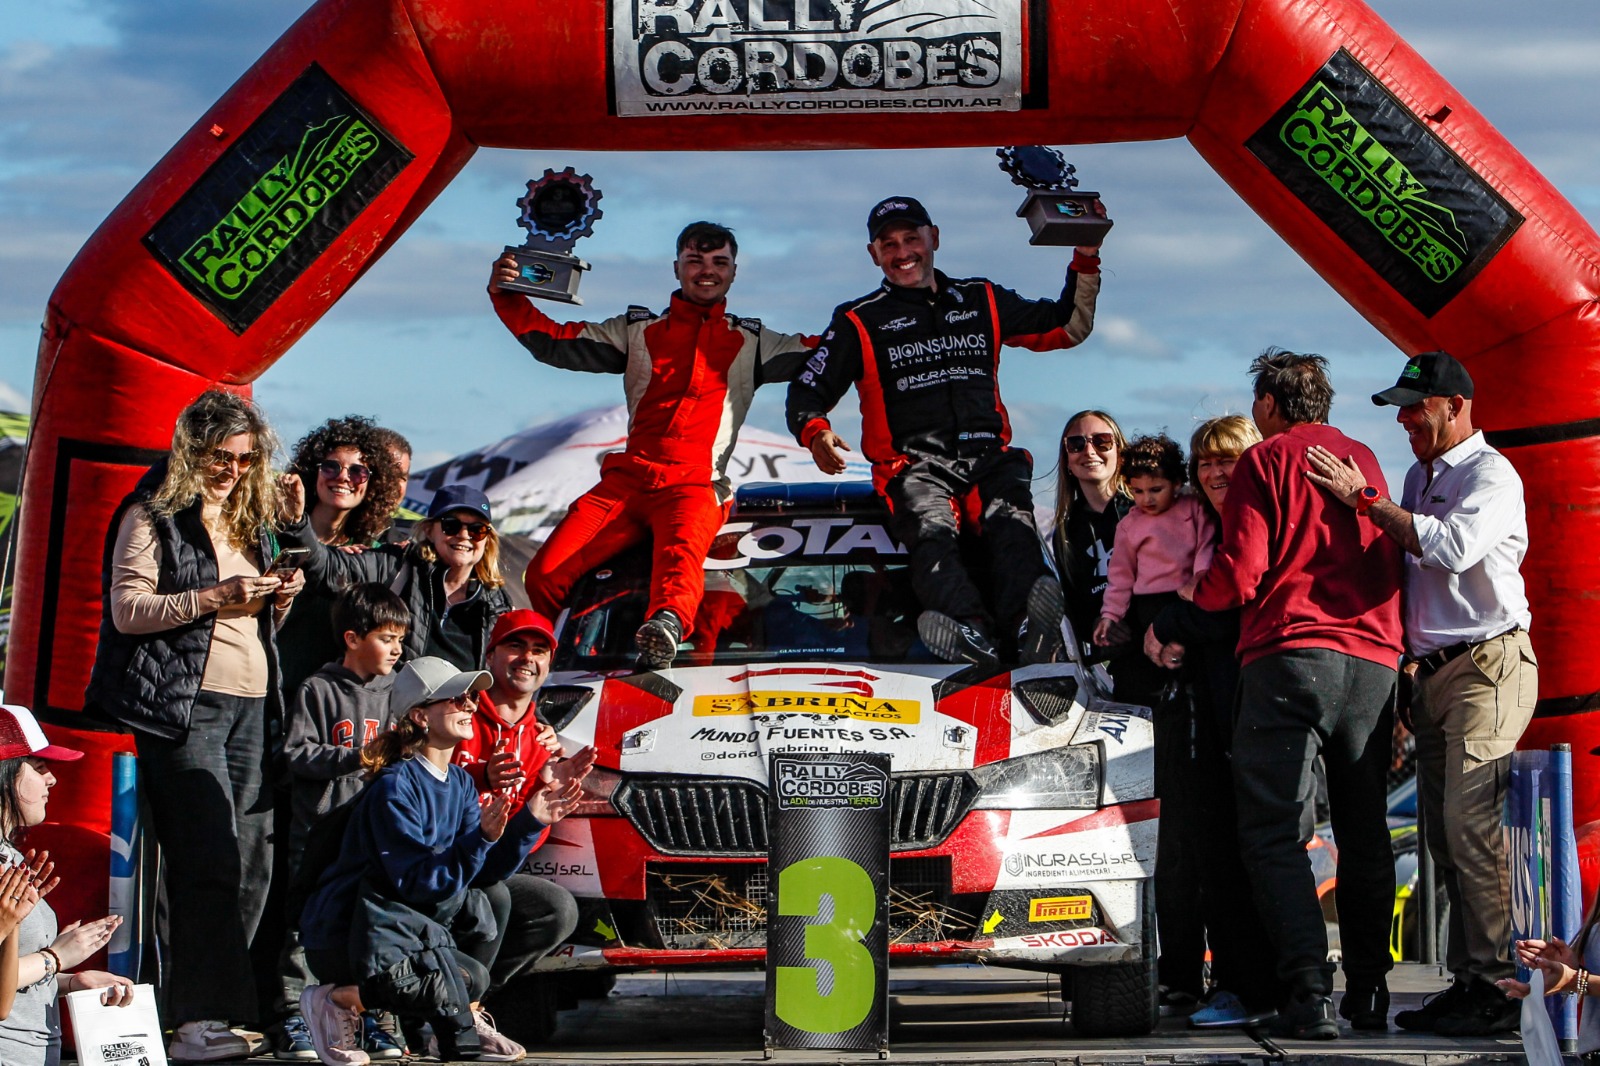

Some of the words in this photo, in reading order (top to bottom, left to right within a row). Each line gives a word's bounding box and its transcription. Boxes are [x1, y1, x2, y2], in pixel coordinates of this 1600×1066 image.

[638, 0, 866, 33] RALLY
[643, 38, 1001, 95] CORDOBES
[646, 98, 1001, 112] WWW.RALLYCORDOBES.COM.AR
[1303, 88, 1424, 198] RALLY
[1284, 118, 1456, 282] CORDOBES
[183, 160, 293, 276] RALLY
[214, 127, 379, 295] CORDOBES
[945, 310, 979, 324] Teodoro
[888, 334, 986, 362] BIOINSUMOS
[702, 518, 909, 570] COTA
[1091, 582, 1109, 594] UND
[711, 697, 899, 713] SABRINA
[332, 719, 398, 748] GA
[689, 727, 759, 743] MUNDO
[767, 727, 864, 742] FUENTES
[869, 727, 915, 741] S.A.
[780, 763, 848, 779] RALLY
[781, 779, 881, 796] CORDOBES
[848, 797, 879, 805] TIERRA
[1024, 852, 1108, 867] INGRASSI
[520, 862, 558, 875] ASSI
[1025, 869, 1068, 878] INGREDIENTI
[1069, 868, 1111, 876] ALIMENTARI
[1035, 900, 1088, 917] PIRELLI
[775, 856, 876, 1034] 3
